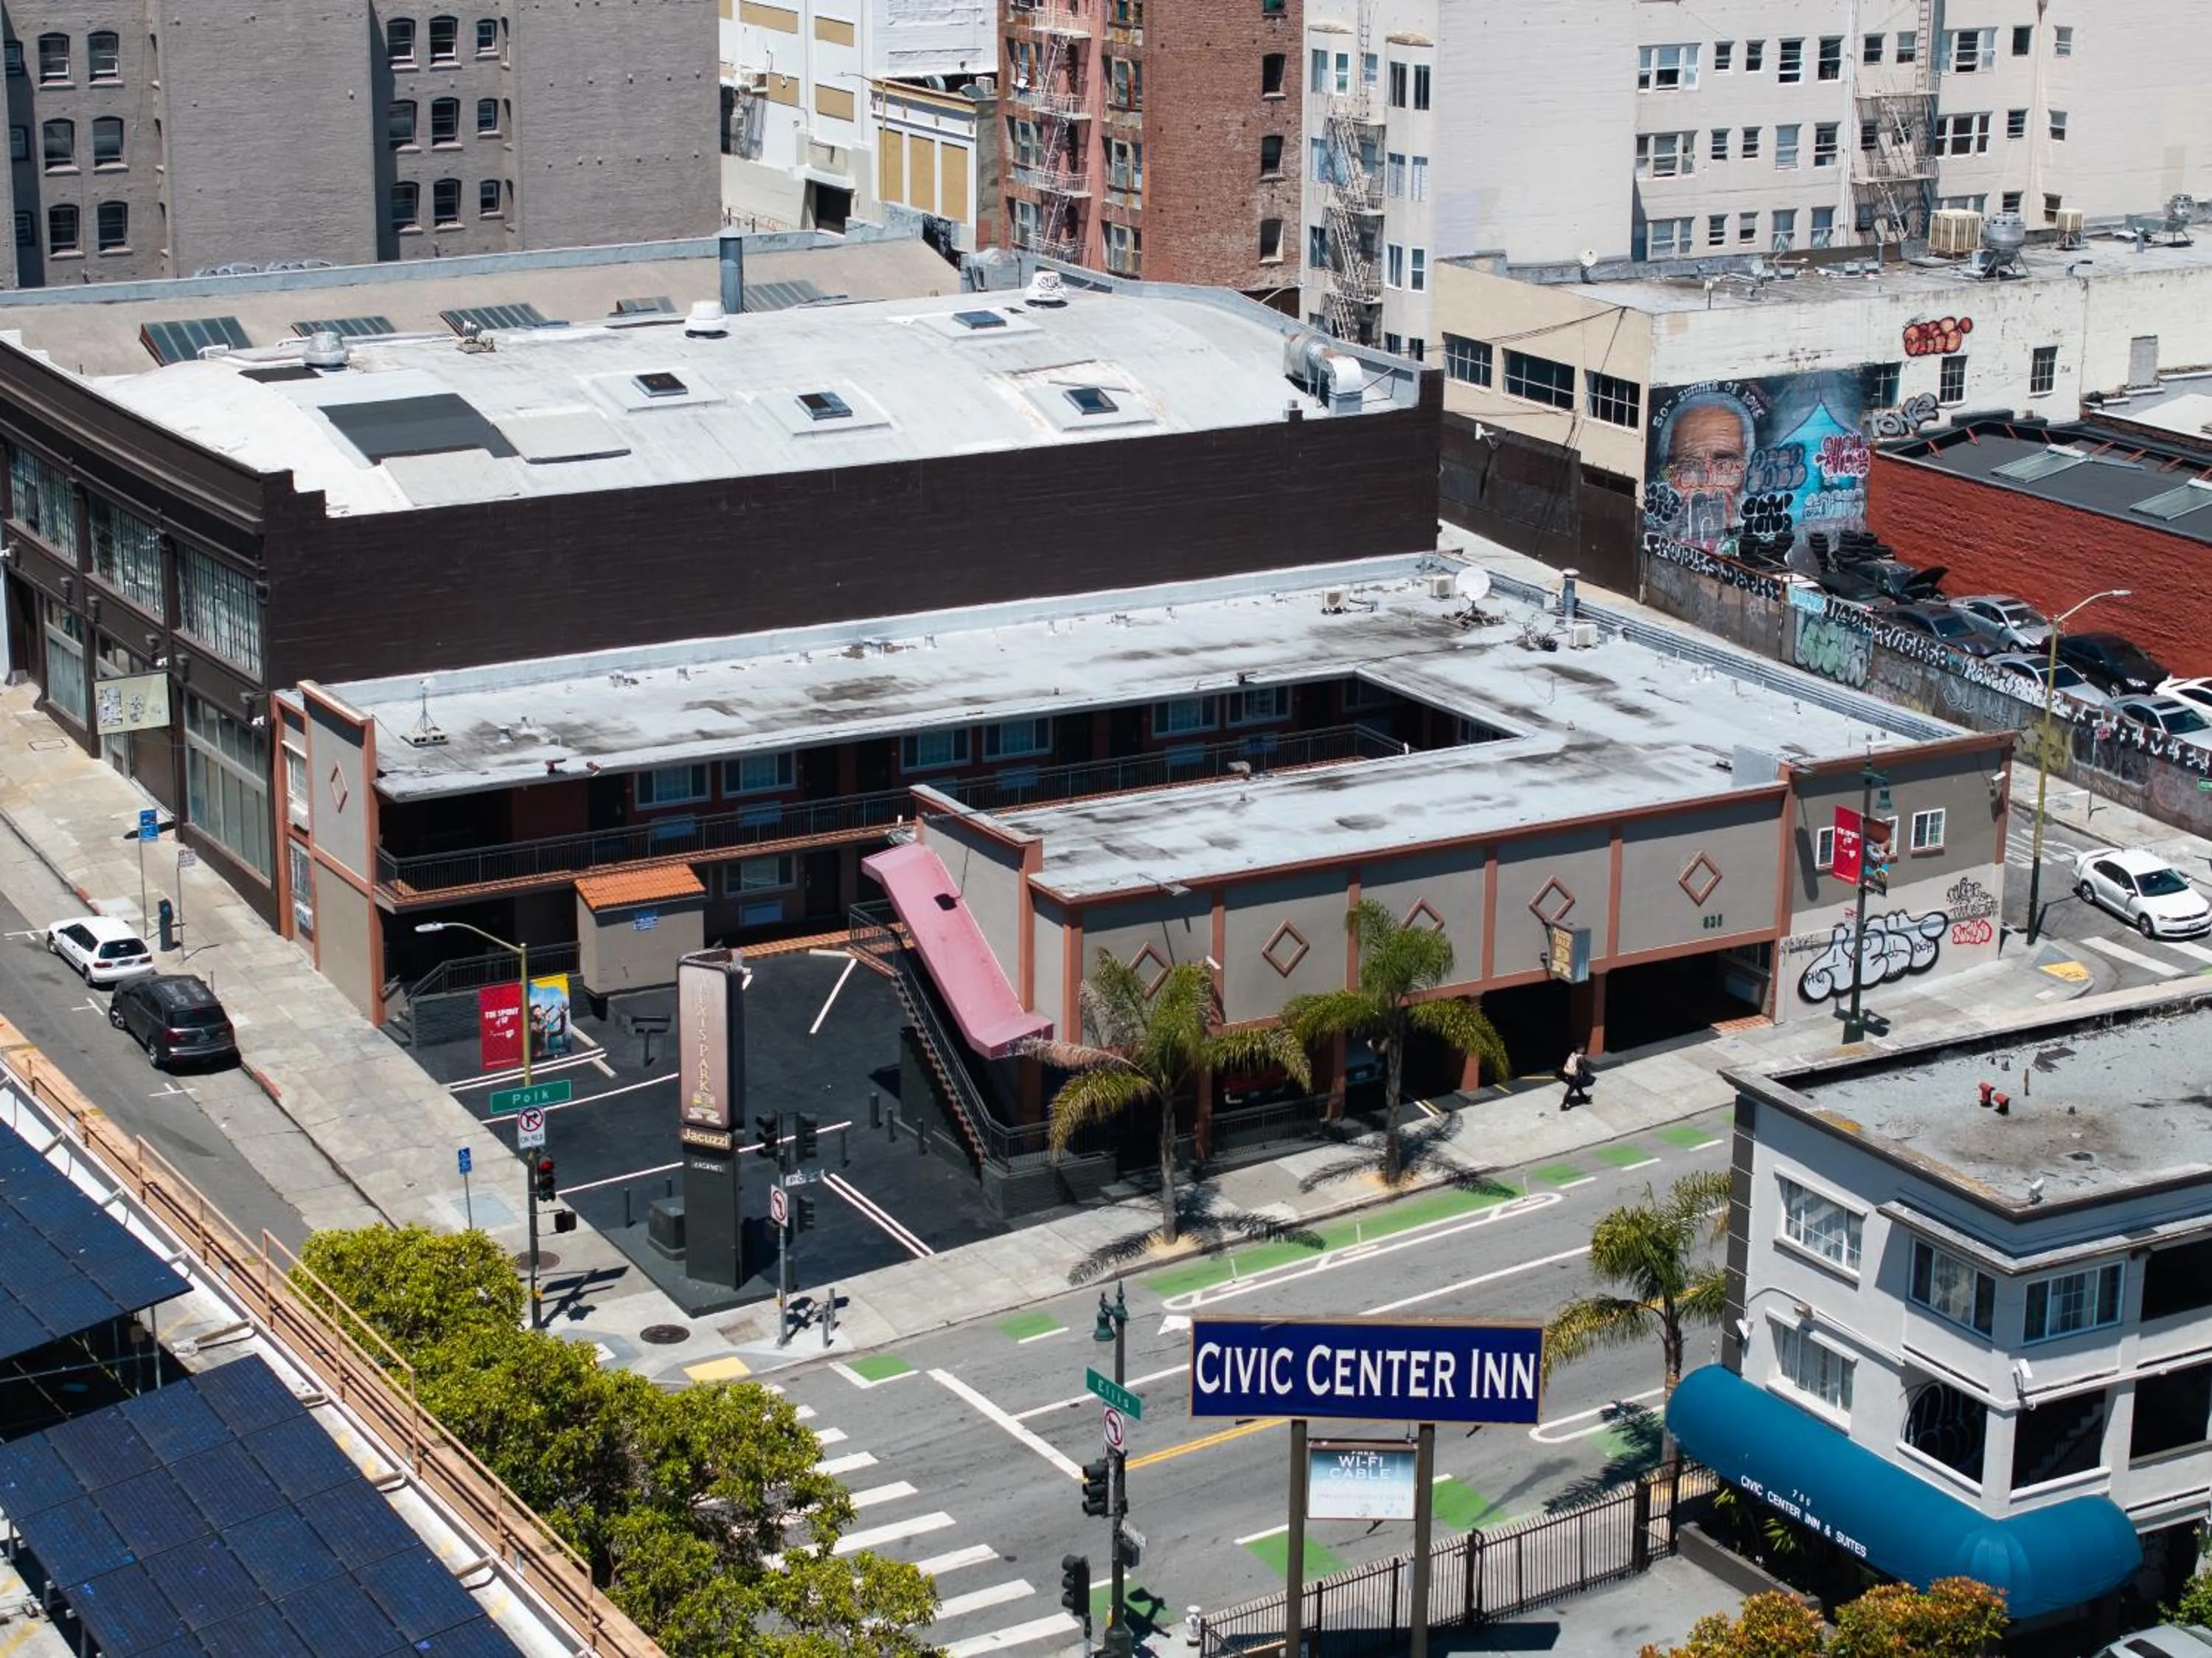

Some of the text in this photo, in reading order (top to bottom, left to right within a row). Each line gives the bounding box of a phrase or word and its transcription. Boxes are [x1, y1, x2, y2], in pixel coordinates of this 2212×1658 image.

[512, 1090, 549, 1104] Polk
[684, 1128, 728, 1148] Jacuzzi
[1196, 1342, 1536, 1400] CIVIC CENTER INN
[1338, 1455, 1384, 1468] WI-FI
[1329, 1467, 1391, 1480] CABLE
[1741, 1475, 1764, 1497] CIVIC
[1767, 1491, 1801, 1519] CENTER
[1805, 1512, 1821, 1531] INN
[1835, 1530, 1868, 1558] SUITES
